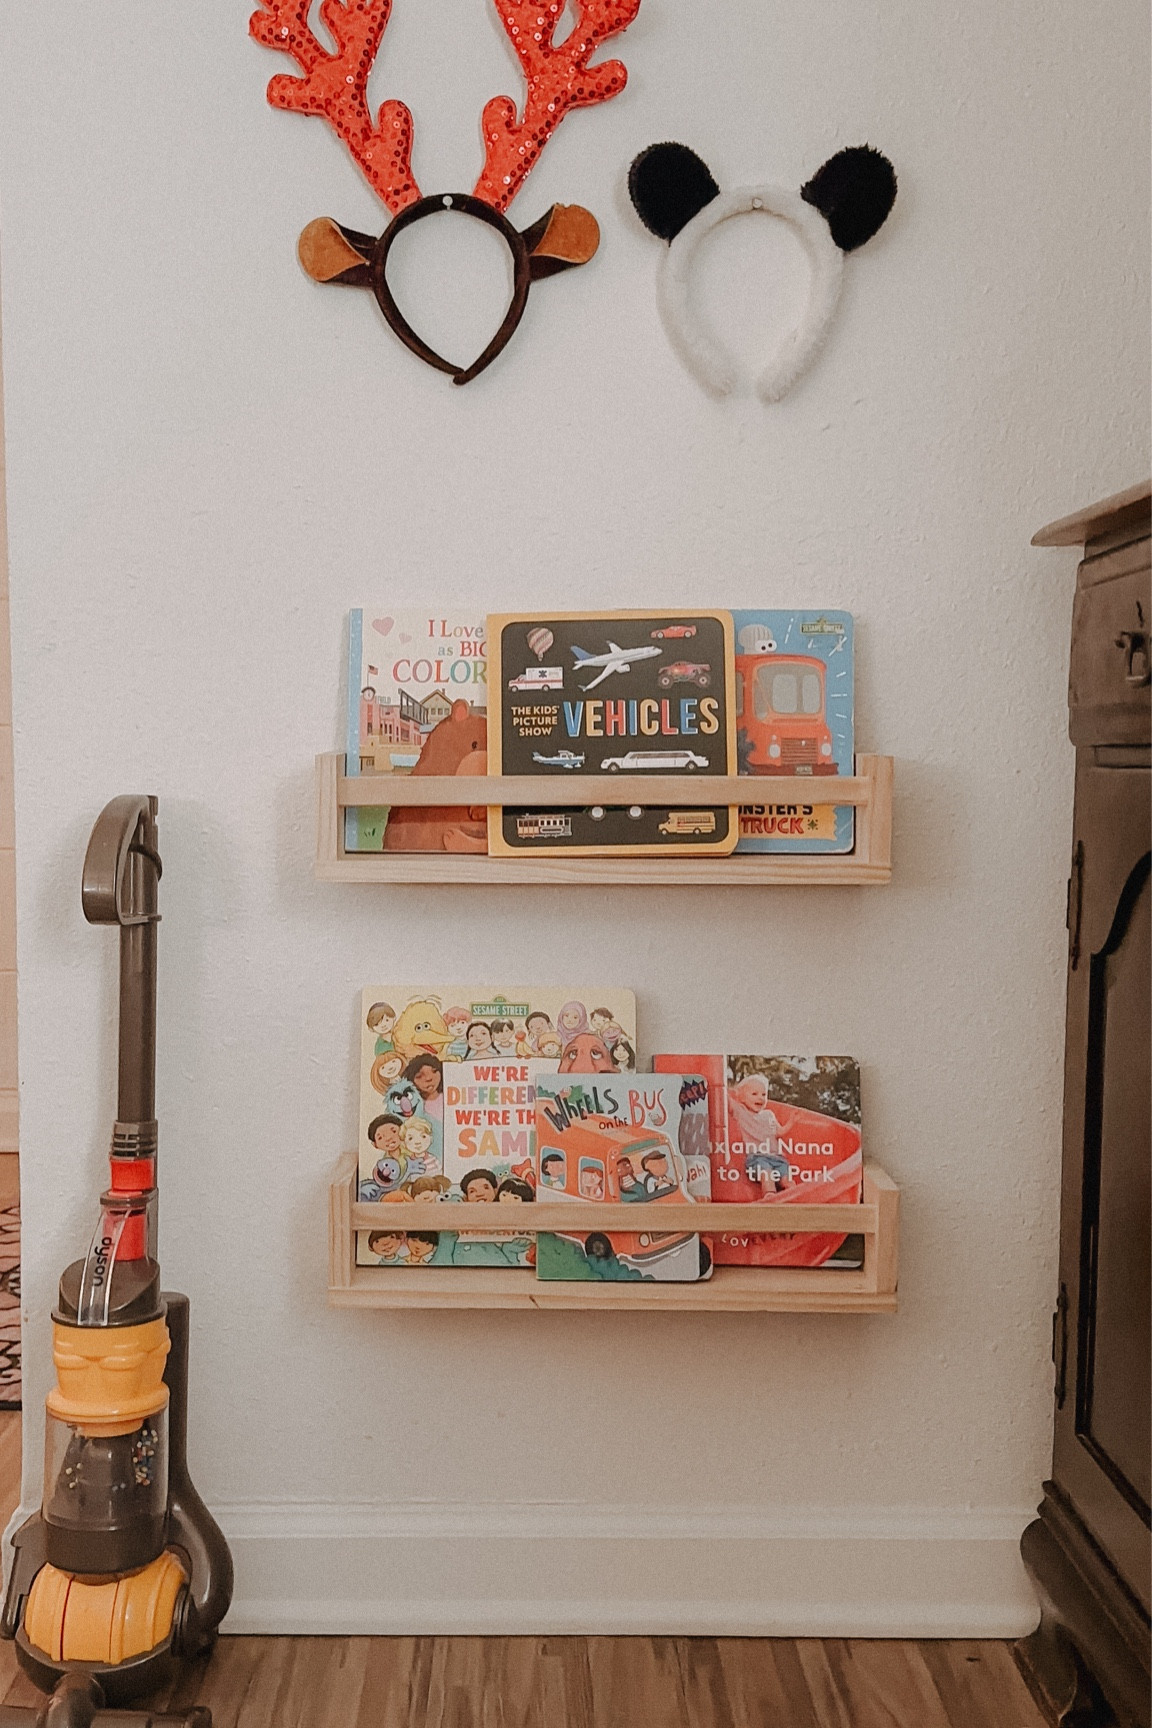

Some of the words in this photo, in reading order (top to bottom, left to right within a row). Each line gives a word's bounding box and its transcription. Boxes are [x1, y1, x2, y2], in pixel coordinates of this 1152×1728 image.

[428, 619, 435, 638] I
[440, 619, 484, 639] Love
[438, 645, 454, 657] as
[393, 658, 488, 685] COLOR
[511, 706, 532, 716] THE
[533, 705, 560, 715] KIDS'
[563, 697, 719, 738] VEHICLES
[513, 716, 558, 726] PICTURE
[519, 727, 553, 737] SHOW
[738, 804, 813, 815] NSTERS
[741, 817, 805, 834] TRUCK
[473, 1005, 501, 1016] SESAME
[502, 1005, 528, 1016] STREET
[473, 1065, 529, 1082] WE'RE
[455, 1109, 511, 1126] WE'RE
[516, 1109, 537, 1125] TH
[598, 1120, 614, 1130] on
[708, 1141, 725, 1154] x
[731, 1138, 771, 1155] and
[778, 1138, 834, 1155] Nana
[717, 1166, 740, 1181] to
[745, 1164, 781, 1182] the
[788, 1165, 835, 1182] Park
[94, 1236, 115, 1287] dyson
